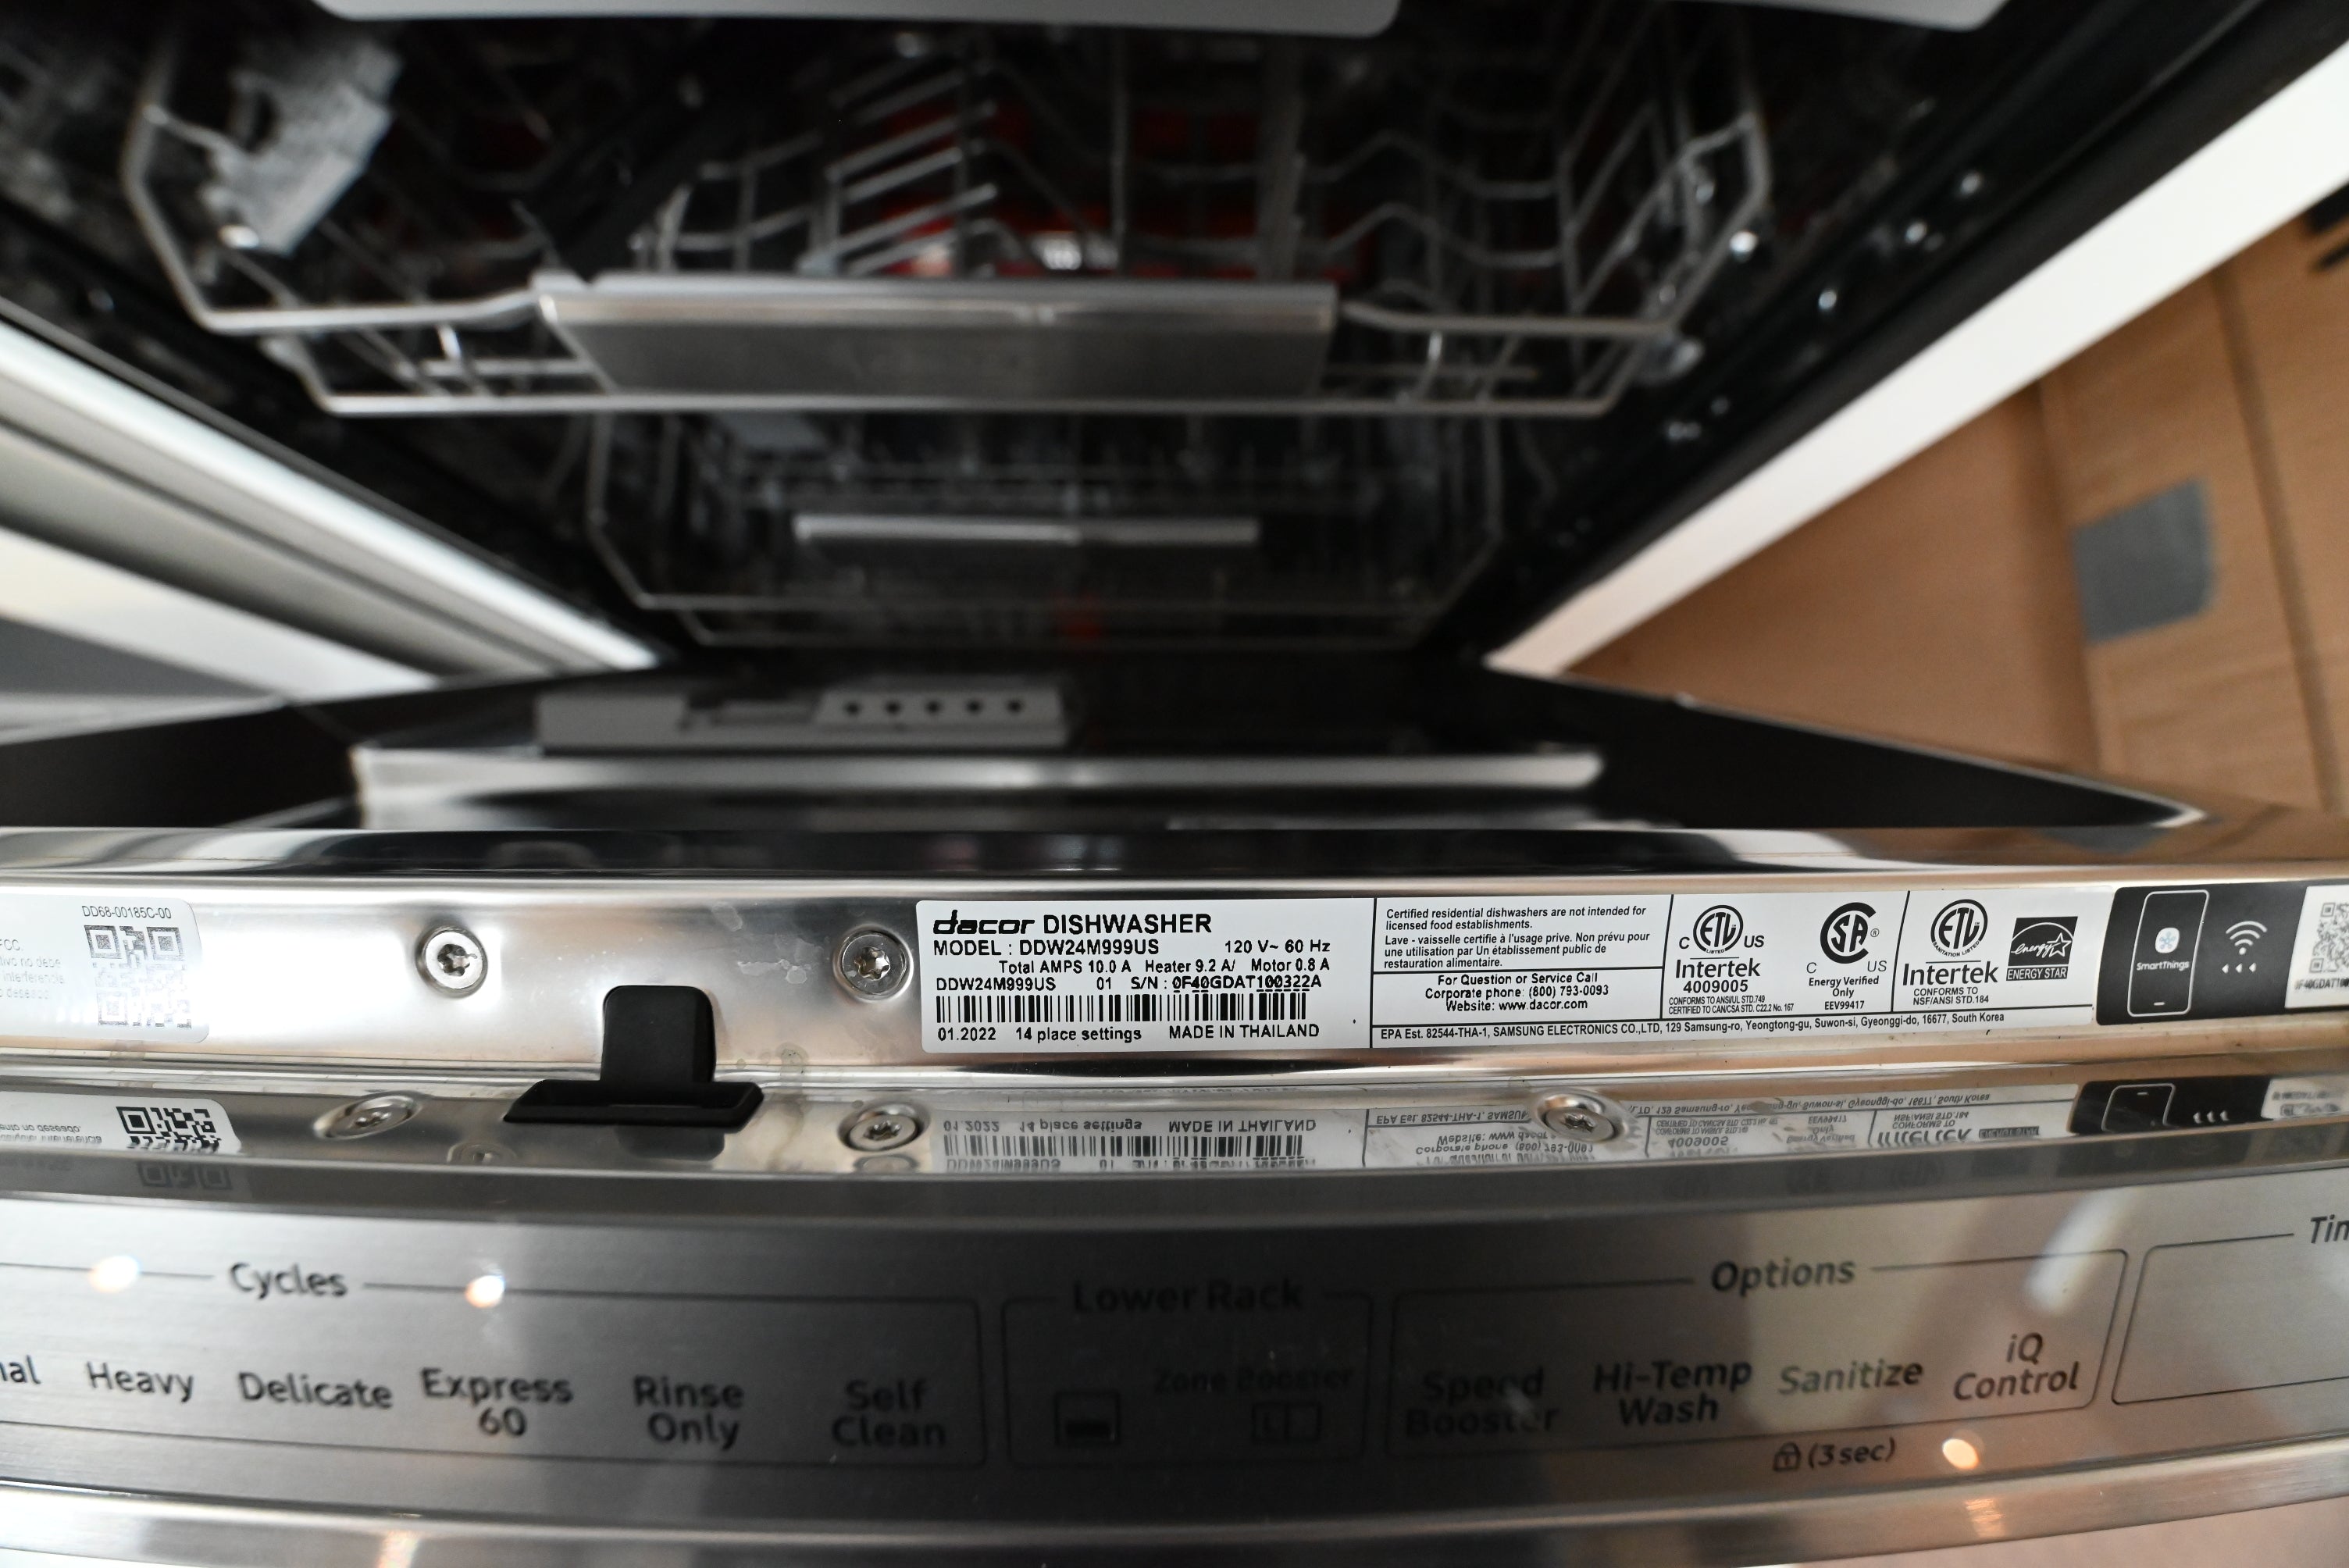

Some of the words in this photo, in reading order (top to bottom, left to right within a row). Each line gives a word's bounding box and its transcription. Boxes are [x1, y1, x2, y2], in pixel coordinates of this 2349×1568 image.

[82, 906, 172, 919] DD68-00185C-00
[1387, 908, 1429, 918] Certified
[1431, 907, 1483, 918] residential
[1486, 907, 1548, 918] dishwashers
[1551, 908, 1566, 917] are
[1569, 907, 1584, 917] not
[1588, 906, 1630, 916] intended
[1632, 906, 1646, 915] for
[932, 909, 1035, 934] dacor
[1043, 914, 1211, 934] DISHWASHER
[1386, 921, 1427, 930] licensed
[1431, 920, 1453, 930] food
[1456, 919, 1532, 929] establishments.
[1225, 939, 1252, 953] 120
[1285, 939, 1303, 953] 60
[1310, 939, 1331, 953] Hz
[1385, 935, 1408, 945] Lave
[1418, 935, 1460, 944] vaisselle
[1463, 933, 1497, 943] certifie
[1500, 934, 1506, 943] à
[1509, 933, 1542, 945] l'usage
[1546, 933, 1572, 944] prive.
[1575, 932, 1595, 942] Non
[1598, 932, 1624, 943] prévu
[1627, 933, 1650, 943] pour
[1744, 935, 1764, 948] US
[934, 939, 1001, 956] MODEL
[1020, 939, 1159, 955] DDW24M999US
[1385, 948, 1403, 957] une
[1406, 946, 1454, 956] utilisation
[1457, 948, 1473, 957] par
[1476, 946, 1489, 955] Un
[1492, 945, 1559, 954] établissement
[1563, 943, 1592, 956] public
[1595, 943, 1606, 953] de
[1933, 942, 1960, 957] SANITATION
[1962, 941, 1980, 956] LISTED
[999, 960, 1034, 974] Total
[1040, 960, 1082, 973] AMPS
[1089, 960, 1117, 973] 10.0
[1121, 960, 1132, 973] A
[1145, 959, 1191, 973] Heater
[1195, 959, 1216, 972] 9.2
[1251, 958, 1292, 971] Motor
[1295, 957, 1316, 971] 0.8
[1320, 957, 1330, 971] A
[1384, 958, 1443, 968] restauration
[1446, 957, 1502, 967] alimentaire.
[1676, 957, 1761, 978] Intertek
[1867, 960, 1887, 972] US
[2136, 960, 2190, 971] SmartThings
[1438, 975, 1457, 985] For
[1460, 975, 1512, 985] Question
[1515, 975, 1527, 984] or
[1531, 973, 1572, 984] Service
[1576, 971, 1598, 982] Call
[1902, 961, 1999, 985] Intertek
[2008, 968, 2043, 980] ENERGY
[2044, 968, 2067, 978] STAR
[936, 977, 1056, 991] DDW24M999US
[1096, 976, 1112, 990] 01
[1131, 976, 1158, 990] S/N
[1683, 979, 1748, 993] 4009005
[1809, 978, 1841, 989] Energy
[1843, 975, 1880, 985] Verified
[1425, 988, 1482, 1000] Corporate
[1485, 987, 1524, 1000] phone:
[1529, 985, 1556, 999] (800)
[1560, 985, 1609, 996] 793-0093
[1832, 987, 1854, 999] Only
[1913, 987, 1964, 996] CONFORMS
[1446, 1000, 1495, 1011] Website:
[1668, 1006, 1701, 1014] CERTIFIED
[1702, 1005, 1711, 1014] TO
[1712, 1004, 1740, 1014] CAN/CSA
[1741, 1004, 1755, 1013] STD.
[1756, 1003, 1772, 1012] C22.2
[1784, 1003, 1795, 1012] 167
[1669, 996, 1705, 1006] CONFORMS
[1707, 996, 1715, 1004] TO
[1741, 995, 1765, 1003] STD.749
[1824, 1000, 1865, 1010] EEV99417
[1913, 996, 1953, 1006] NSF/ANSI
[1955, 996, 1989, 1004] STD.184
[938, 1027, 996, 1041] 01.2022
[1016, 1027, 1032, 1040] 14
[1037, 1026, 1076, 1043] place
[1082, 1026, 1142, 1043] settings
[1169, 1025, 1214, 1039] MADE
[1220, 1025, 1234, 1039] IN
[1240, 1024, 1320, 1039] THAILAND
[1381, 1029, 1403, 1039] EPA
[1406, 1029, 1423, 1039] Est.
[1426, 1027, 1490, 1039] 82544-THA-1,
[1493, 1026, 1545, 1037] SAMSUNG
[1547, 1025, 1618, 1035] ELECTRONICS
[1666, 1022, 1681, 1032] 129
[1684, 1021, 1743, 1034] Samsung-ro,
[1745, 1020, 1812, 1031] Yeongtong-gu,
[1815, 1017, 1859, 1029] Suwon-si,
[1861, 1015, 1919, 1028] Gyeonggi-do,
[1923, 1014, 1949, 1025] 16677,
[1952, 1014, 1977, 1023] South
[1980, 1012, 2004, 1022] Korea
[229, 1262, 350, 1299] Cycles
[1710, 1256, 1856, 1298] Options
[1072, 1277, 1198, 1313] Lower
[1207, 1277, 1304, 1312] Rack
[2005, 1331, 2044, 1365] iQ
[86, 1360, 194, 1403] Heavy
[1422, 1365, 1545, 1406] Speed
[1592, 1360, 1751, 1394] Hi-Temp
[1777, 1358, 1924, 1396] Sanitize
[1954, 1361, 2080, 1402] Control
[237, 1372, 393, 1409] Delicate
[420, 1367, 575, 1406] Express
[633, 1374, 746, 1410] Rinse
[846, 1376, 929, 1413] Self
[1618, 1392, 1720, 1427] Wash
[478, 1407, 528, 1438] 60
[1406, 1405, 1558, 1437] Booster
[647, 1412, 741, 1452] Only
[832, 1415, 947, 1448] Clean
